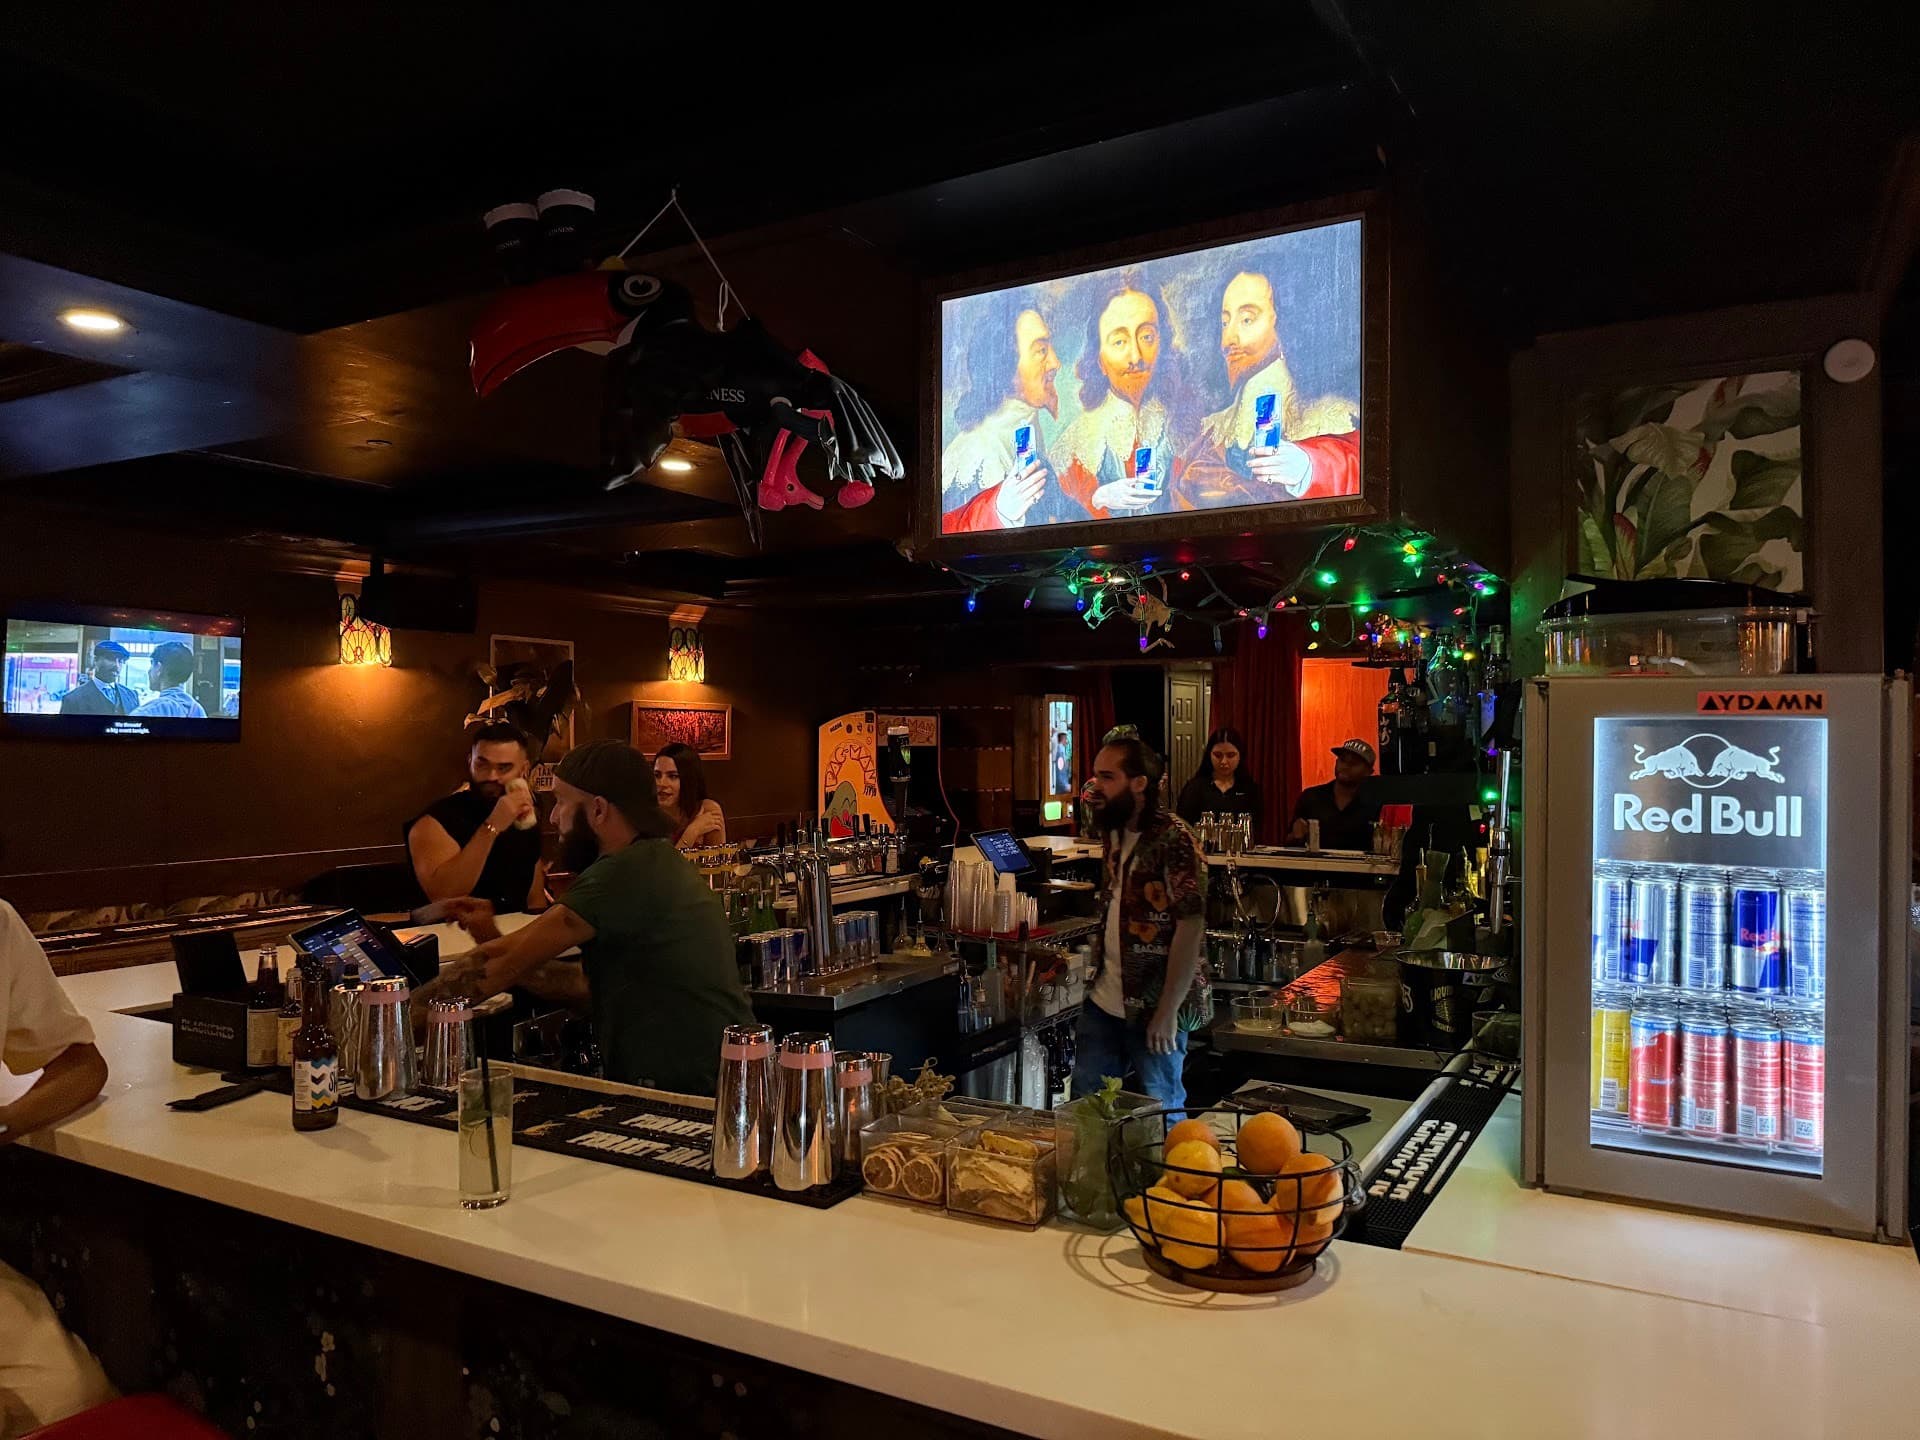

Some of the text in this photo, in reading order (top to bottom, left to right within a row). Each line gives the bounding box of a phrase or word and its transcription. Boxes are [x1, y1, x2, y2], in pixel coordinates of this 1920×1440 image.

[1702, 694, 1823, 711] AYDAMN
[1613, 793, 1802, 837] Red Bull
